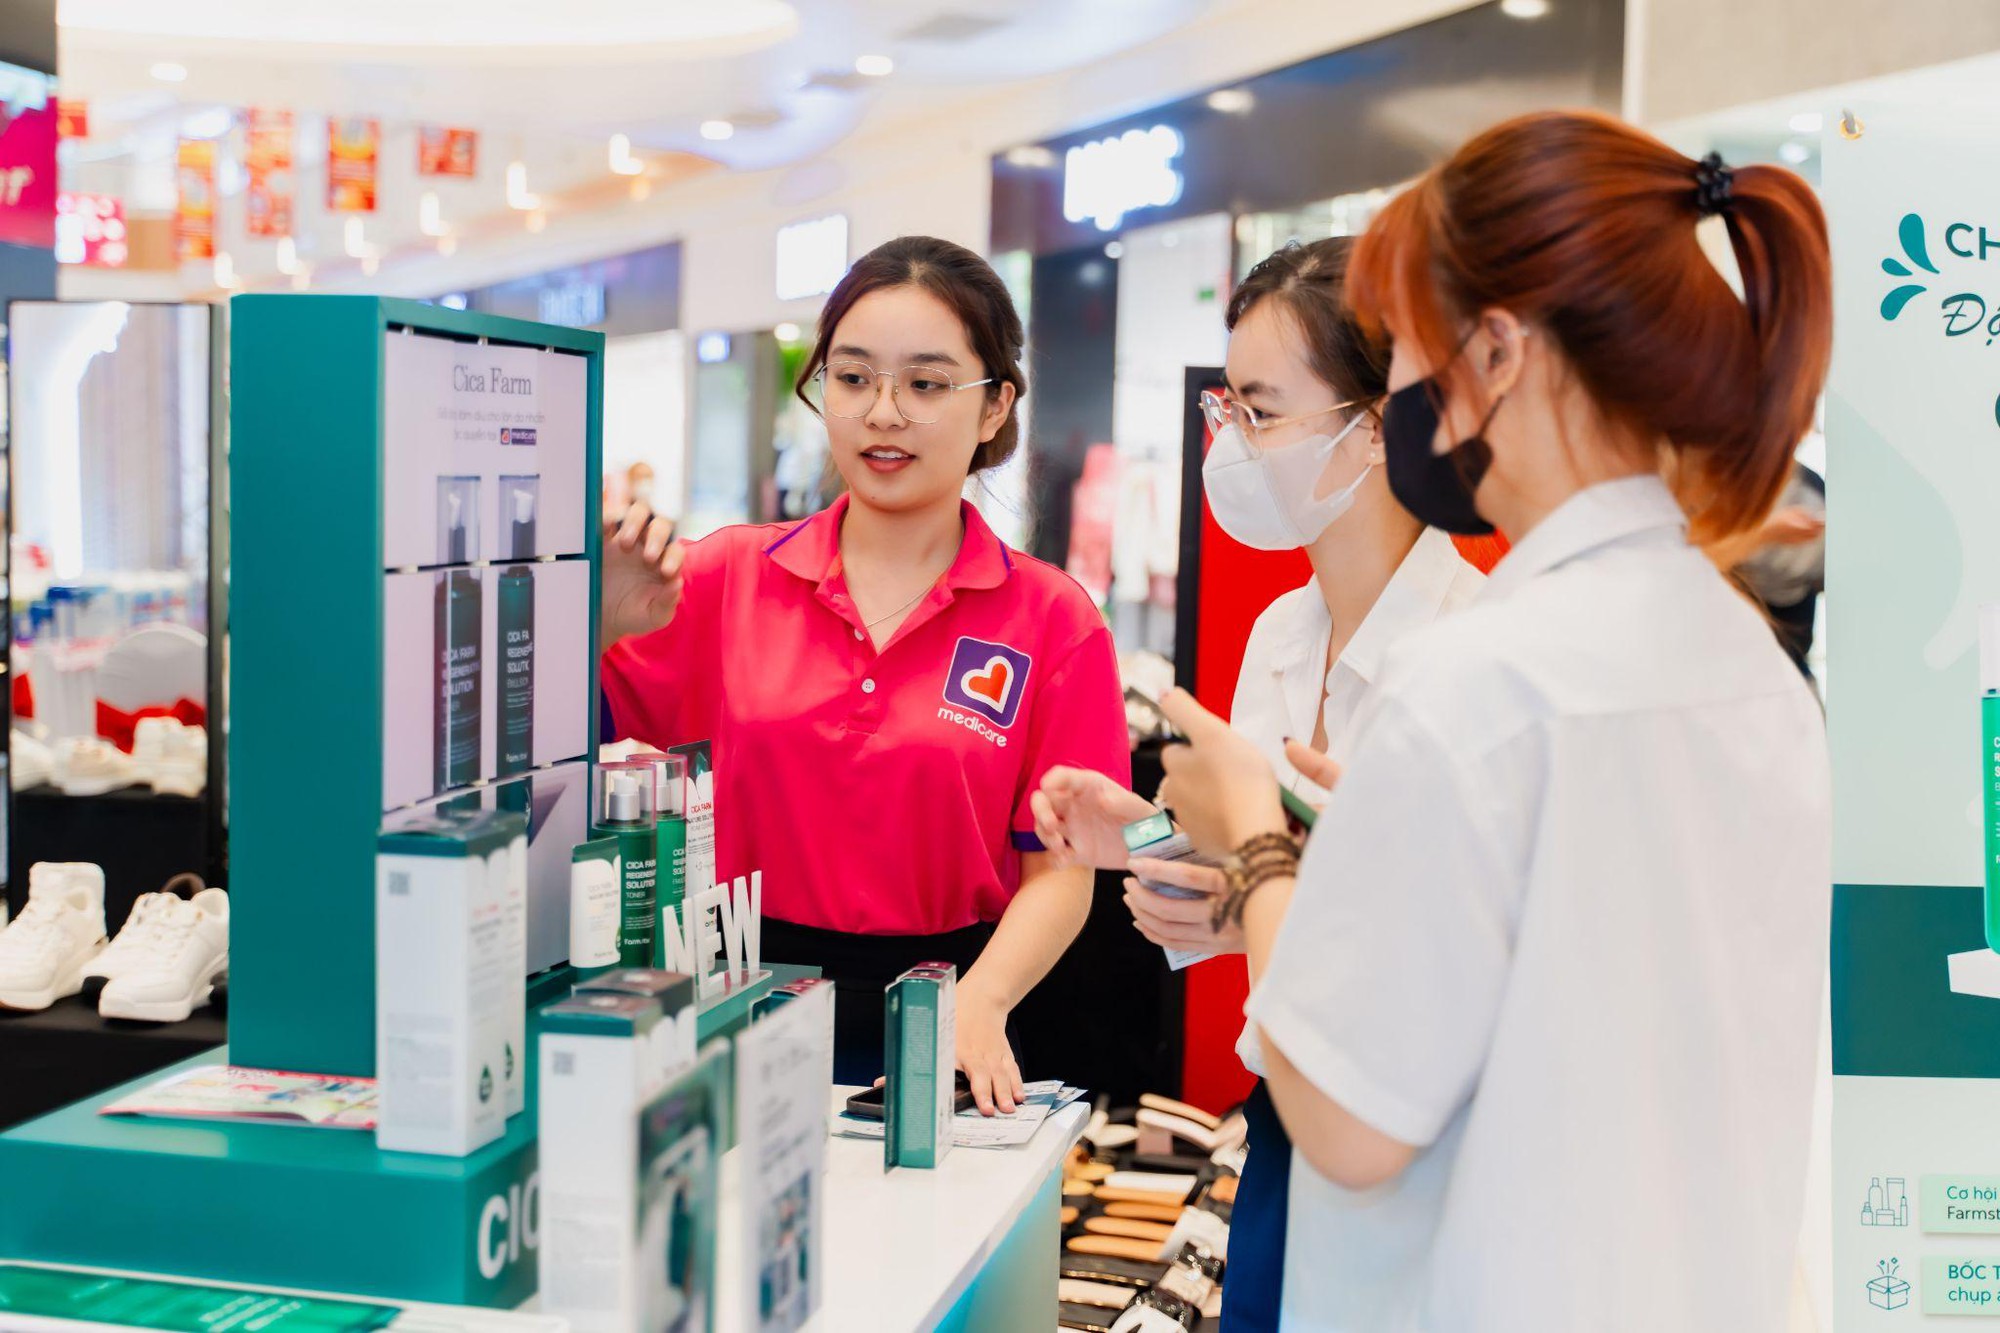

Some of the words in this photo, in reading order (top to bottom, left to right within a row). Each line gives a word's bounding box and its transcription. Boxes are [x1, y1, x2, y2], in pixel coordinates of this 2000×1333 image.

[453, 364, 486, 393] Cica
[490, 367, 532, 395] Farm
[937, 707, 1008, 748] medicare
[625, 861, 644, 870] CICA
[662, 870, 763, 1001] NEW
[1946, 1185, 1969, 1200] Cơ
[1973, 1186, 1998, 1203] hội
[1948, 1260, 1987, 1280] BỐC
[1948, 1286, 1992, 1305] chụp
